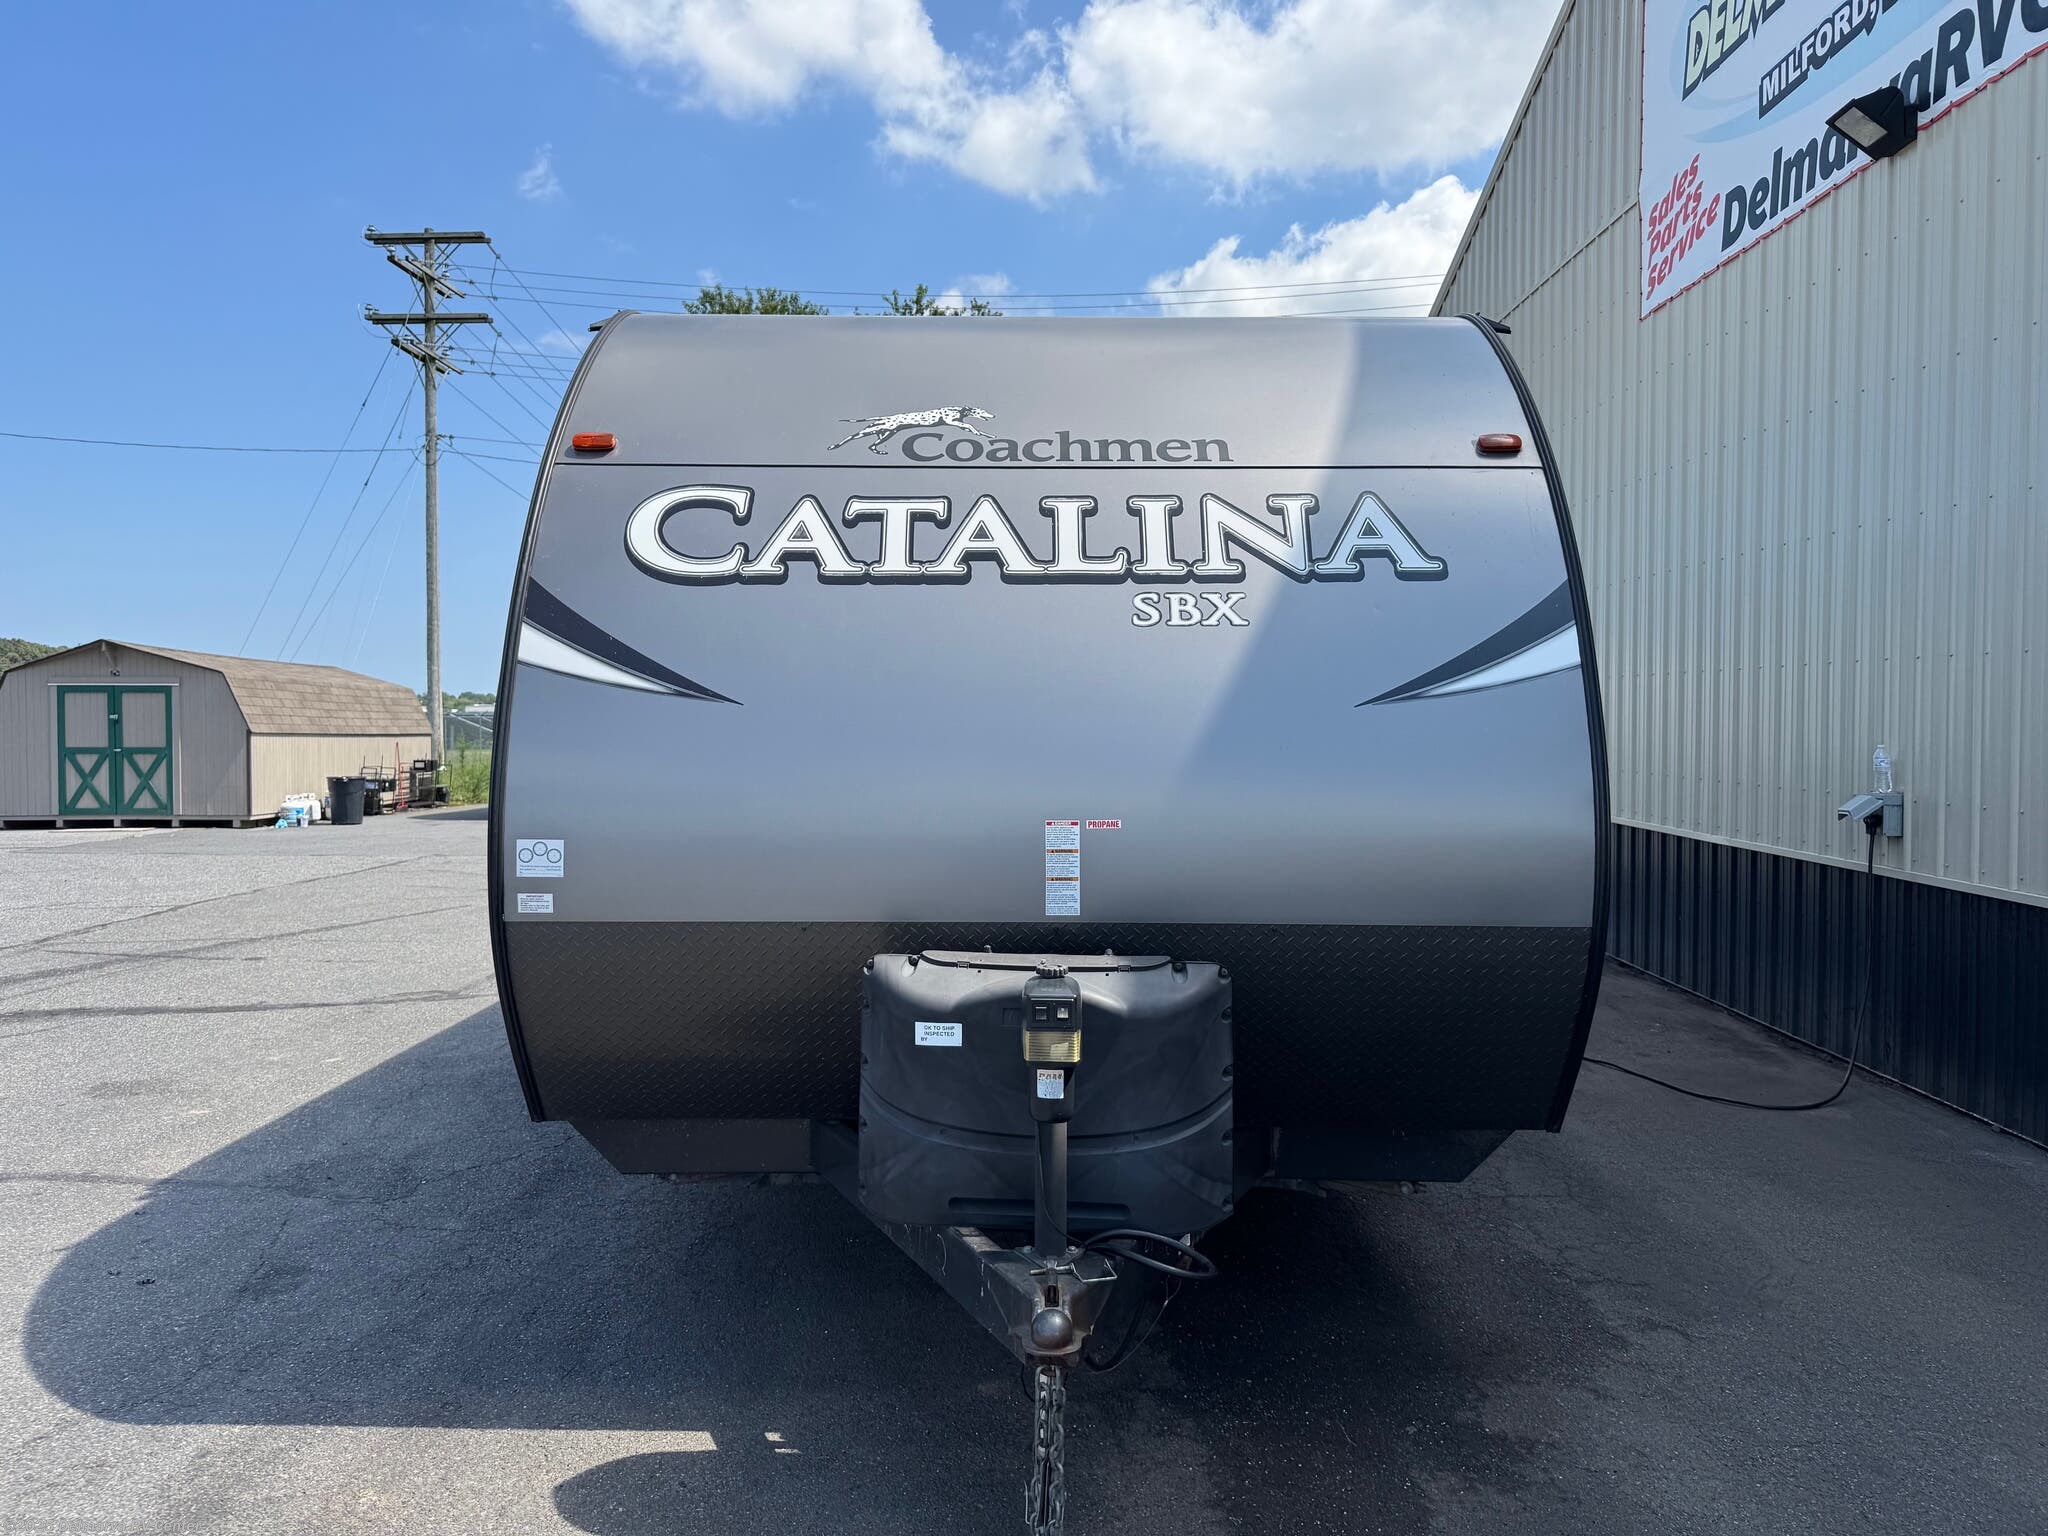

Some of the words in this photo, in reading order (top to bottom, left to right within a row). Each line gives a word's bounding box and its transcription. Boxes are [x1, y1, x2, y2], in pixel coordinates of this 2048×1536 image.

[1759, 0, 1880, 119] MILFORD,
[1646, 152, 1701, 241] Sales
[1647, 180, 1704, 270] Parts
[1646, 192, 1721, 300] Service
[902, 431, 1234, 464] Coachmen
[624, 483, 1449, 585] CATALINA
[1131, 592, 1251, 628] SBX
[1087, 820, 1120, 828] PROPANE
